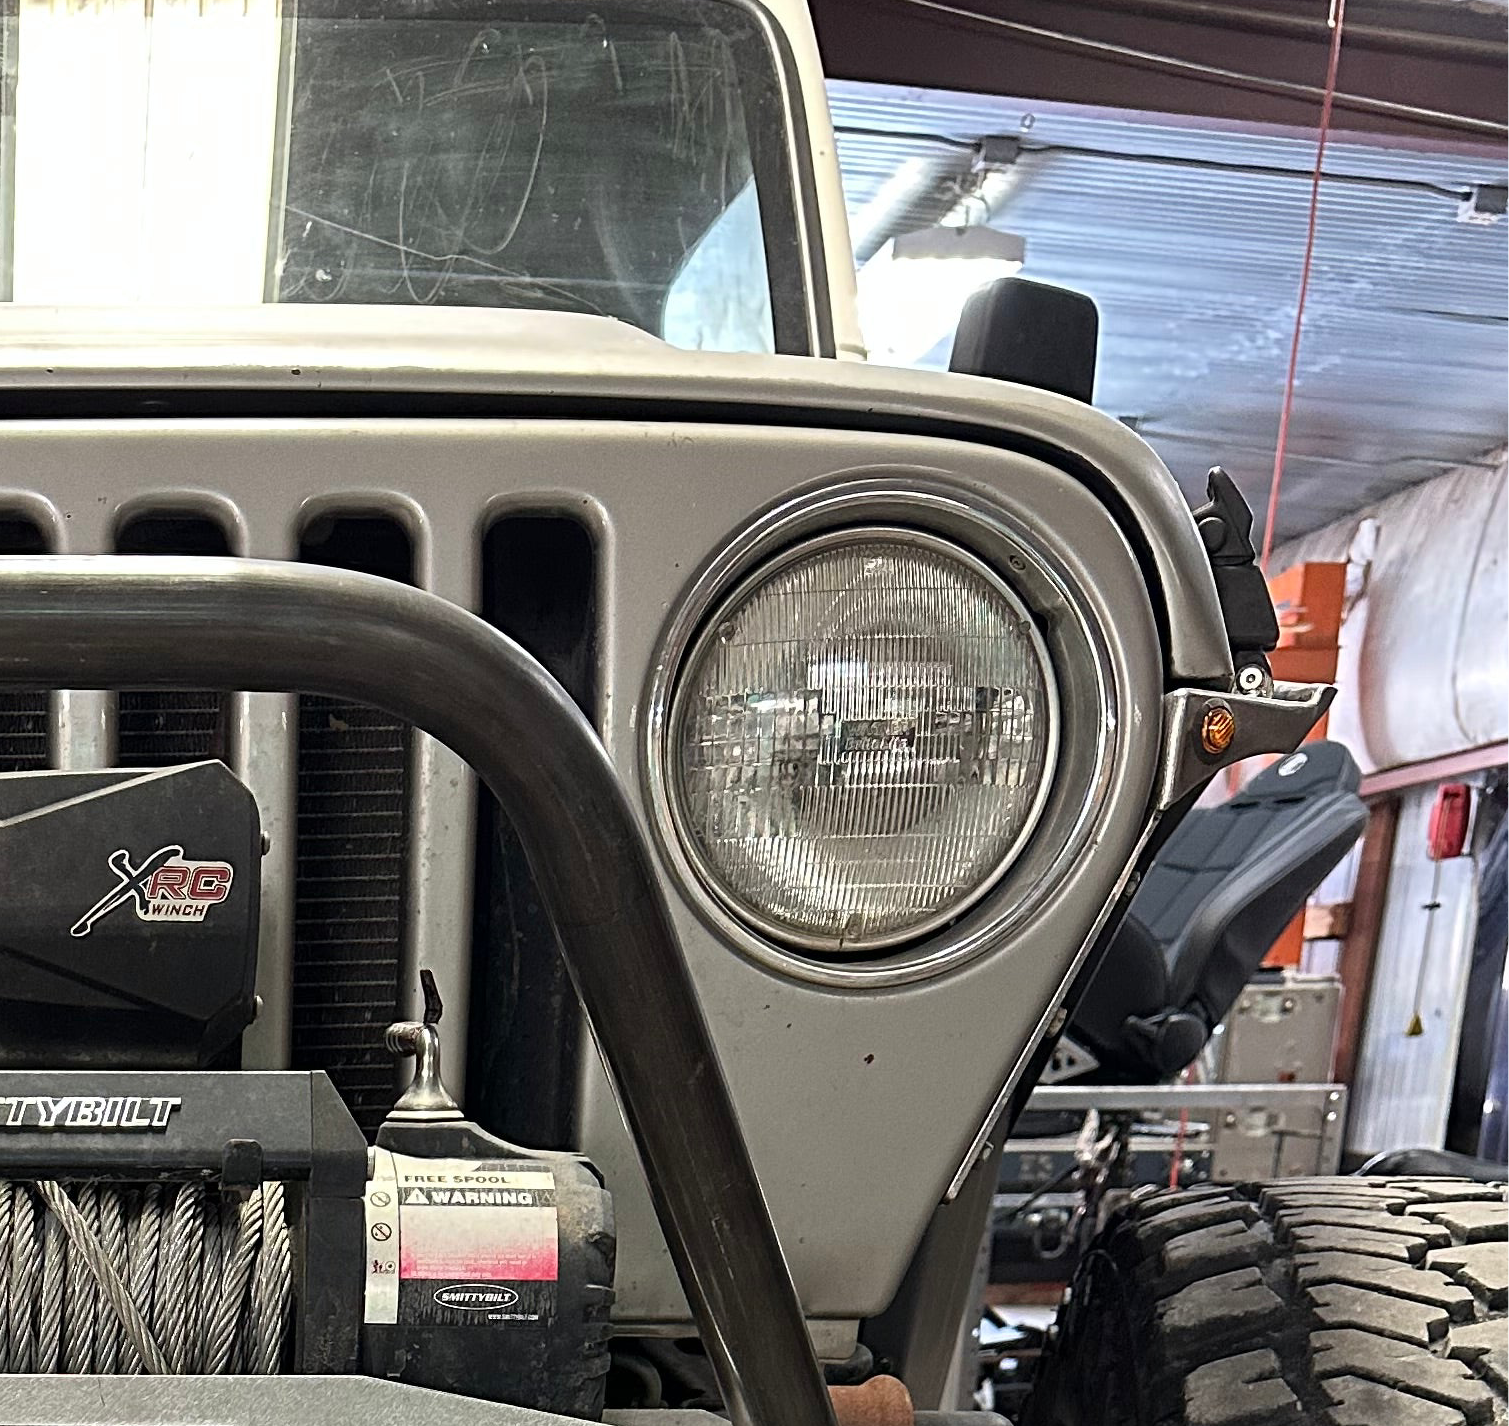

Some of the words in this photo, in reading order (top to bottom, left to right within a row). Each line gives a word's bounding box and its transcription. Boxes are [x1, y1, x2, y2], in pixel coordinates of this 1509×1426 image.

[71, 845, 233, 936] XRC
[151, 904, 208, 917] WINCH
[404, 1175, 447, 1184] FREE
[453, 1175, 511, 1184] SPOOL
[432, 1192, 533, 1205] WARNING
